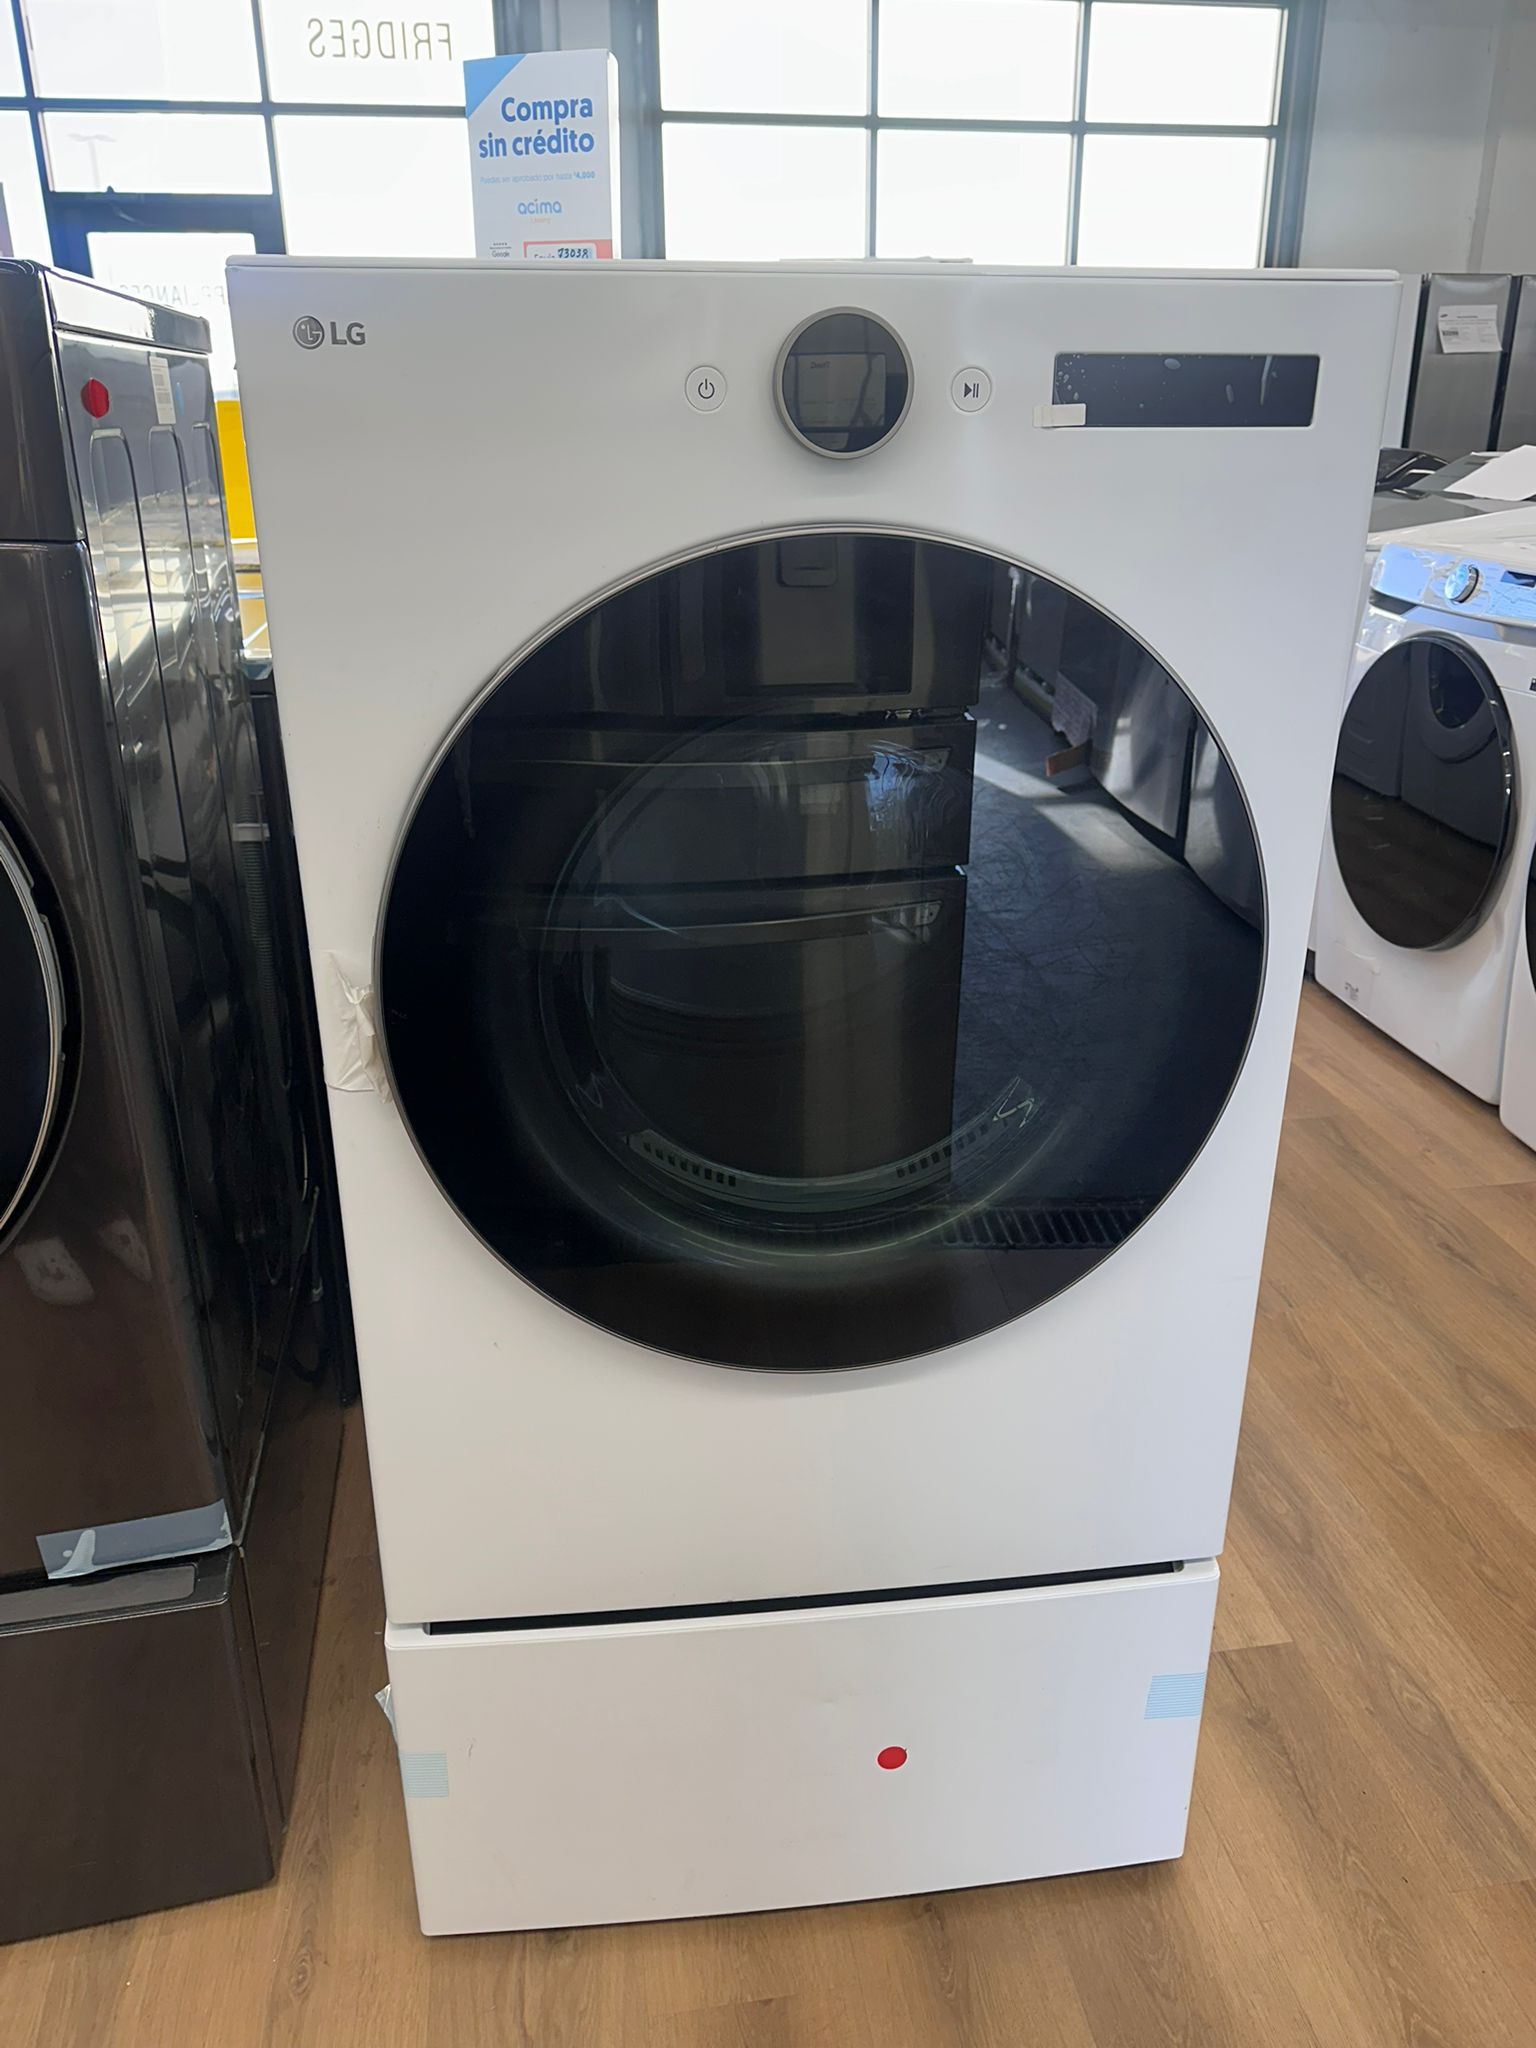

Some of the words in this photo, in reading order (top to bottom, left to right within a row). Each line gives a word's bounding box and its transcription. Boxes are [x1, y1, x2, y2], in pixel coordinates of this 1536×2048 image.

[501, 96, 593, 125] Compra
[479, 132, 507, 158] sin
[512, 127, 594, 156] crédito
[517, 198, 563, 215] acima
[329, 321, 366, 346] LG
